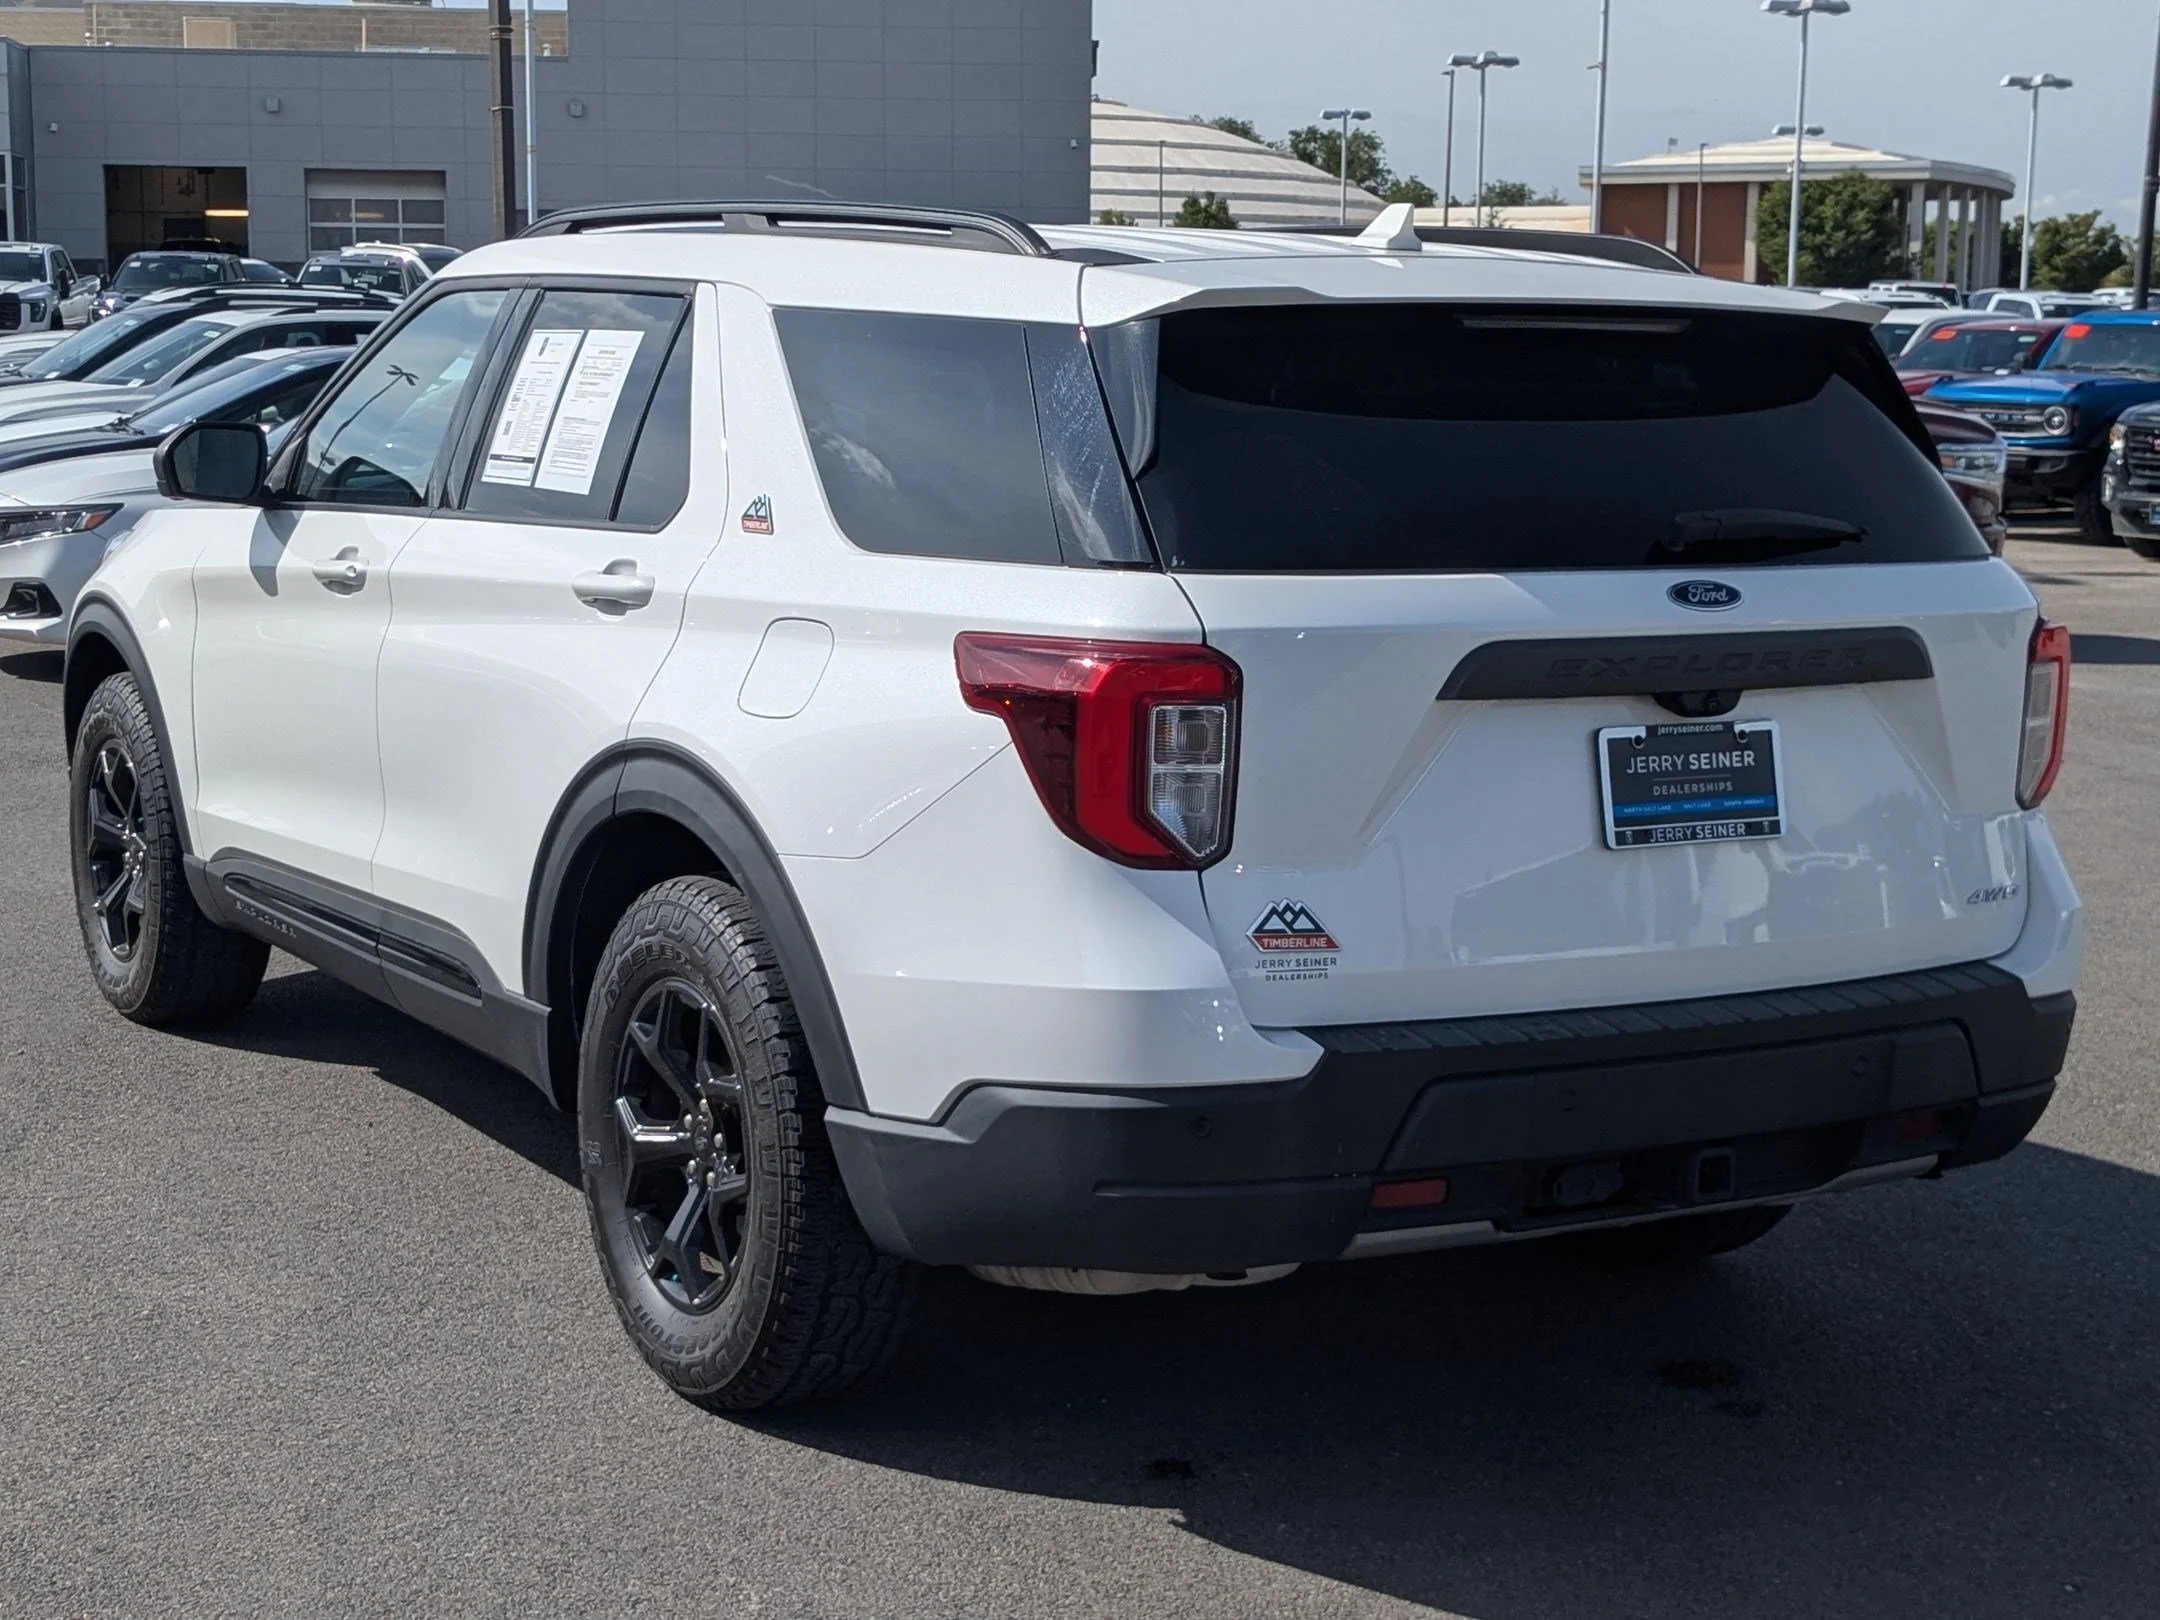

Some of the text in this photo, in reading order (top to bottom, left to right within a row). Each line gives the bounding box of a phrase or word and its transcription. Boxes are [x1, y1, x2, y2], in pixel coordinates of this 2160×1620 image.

[1688, 584, 1729, 603] Ford
[1548, 648, 1866, 680] EXPLORER
[1657, 722, 1724, 736] jerryseiner.com
[1626, 750, 1756, 774] JERRY SEINER
[1652, 780, 1734, 796] DEALERSHIPS
[1650, 823, 1746, 843] JERRY SEINER
[1261, 937, 1328, 948] TIMBERLINE
[1255, 957, 1337, 969] JERRY SEINER
[1265, 972, 1329, 982] DEALERSHIPS
